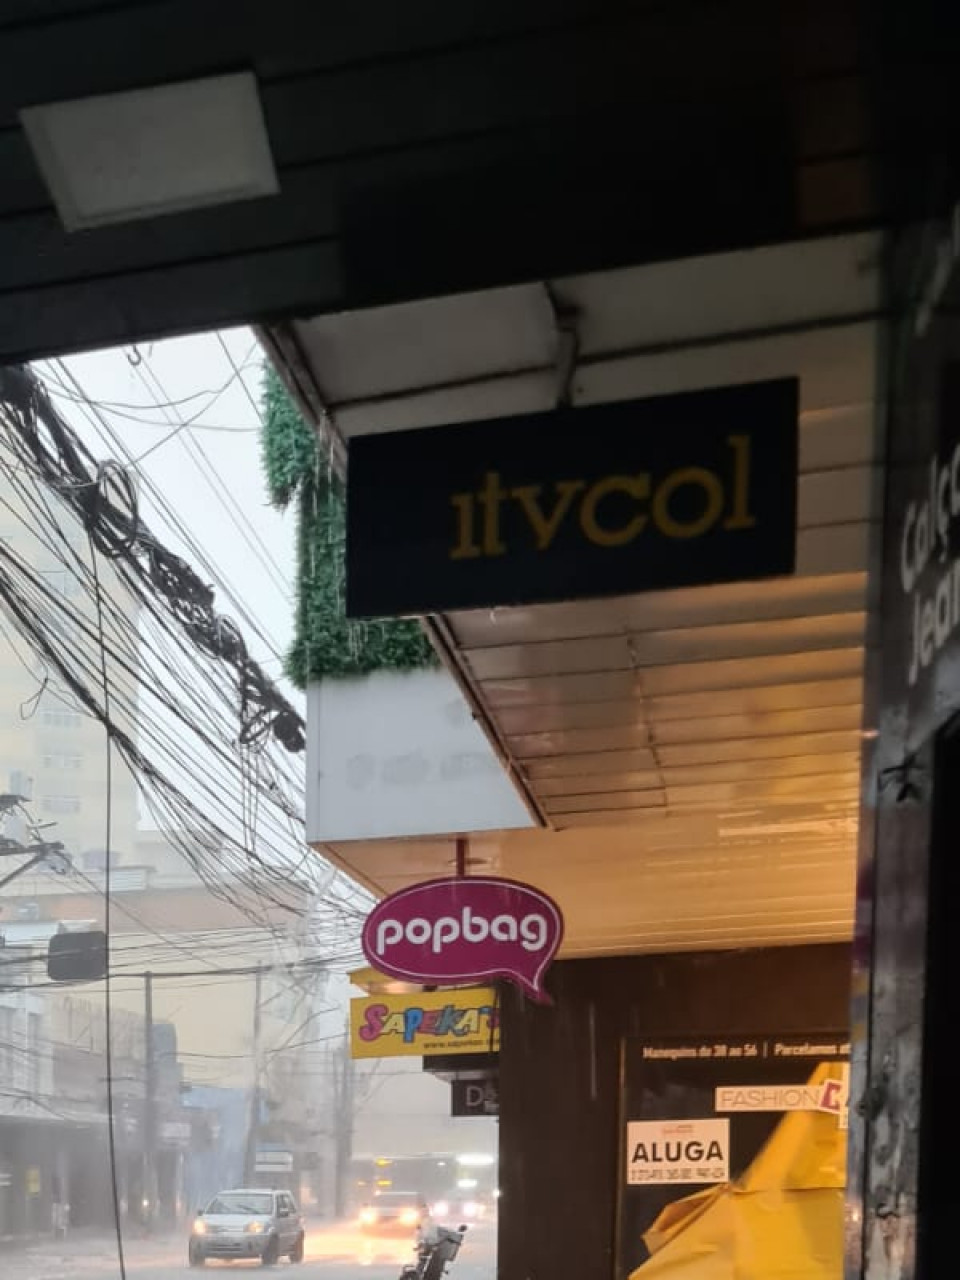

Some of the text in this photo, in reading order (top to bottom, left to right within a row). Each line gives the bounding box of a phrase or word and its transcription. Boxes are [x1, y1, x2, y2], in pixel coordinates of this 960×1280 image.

[376, 906, 548, 956] popbag
[720, 1089, 821, 1107] FASHION
[632, 1141, 724, 1163] ALUGA
